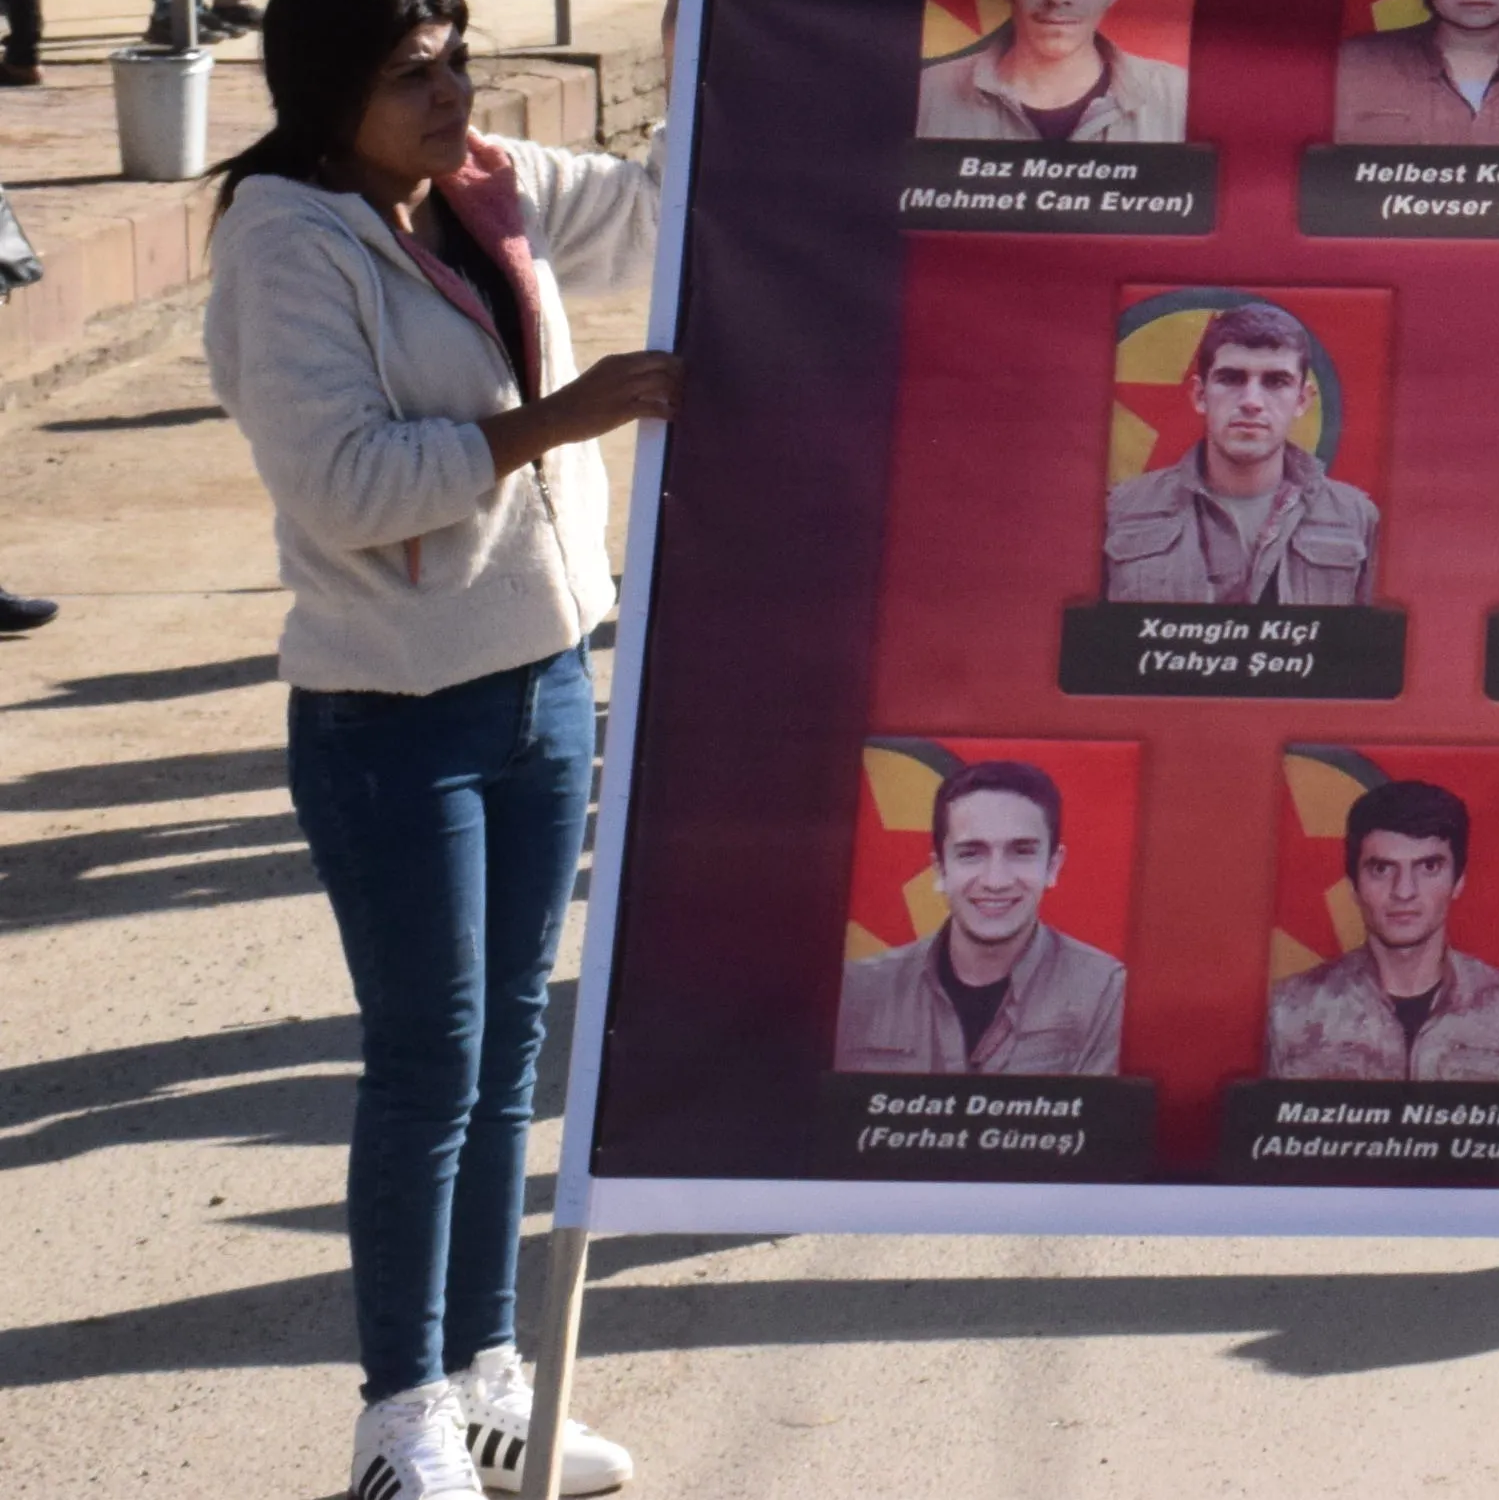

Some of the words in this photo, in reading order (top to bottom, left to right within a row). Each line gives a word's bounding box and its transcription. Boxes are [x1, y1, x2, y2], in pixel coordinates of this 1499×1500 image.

[959, 158, 1011, 178] Baz
[1021, 159, 1137, 179] Mordem
[1354, 163, 1467, 182] Helbest
[899, 188, 1026, 212] (Mehmet
[1036, 191, 1090, 211] Can
[1100, 192, 1193, 216] Evren)
[1381, 195, 1491, 219] (Kevser
[1139, 620, 1248, 644] Xemgîn
[1260, 620, 1319, 646] Kiçî
[1139, 651, 1239, 674] (Yahya
[1248, 652, 1314, 676] Şen)
[868, 1095, 956, 1115] Sedat
[966, 1097, 1083, 1117] Demhat
[1277, 1103, 1391, 1124] Mazlum
[858, 1126, 969, 1152] (Ferhat
